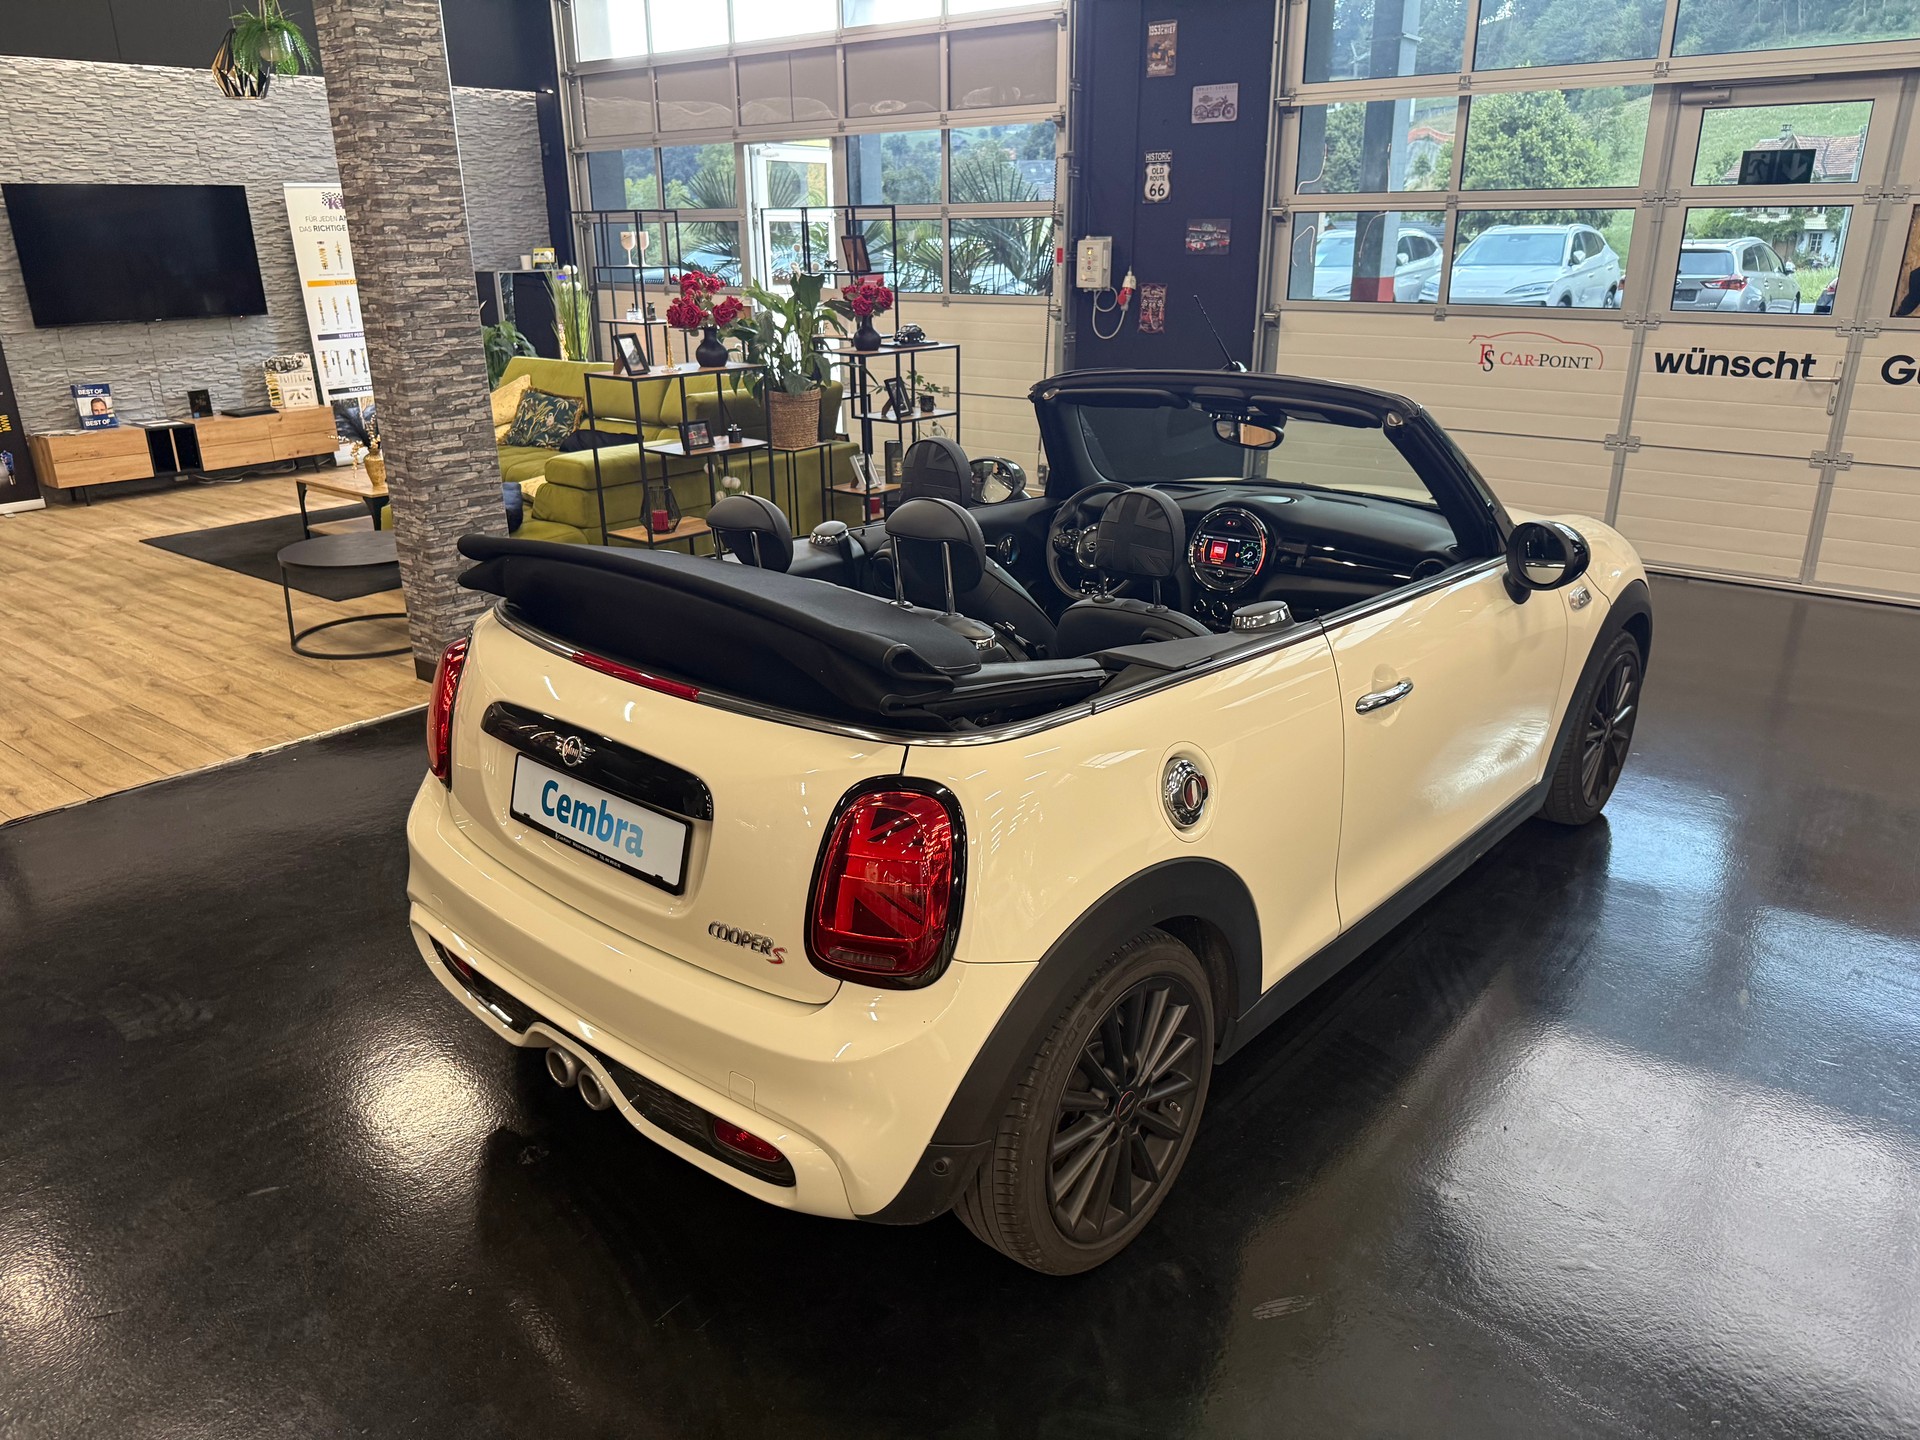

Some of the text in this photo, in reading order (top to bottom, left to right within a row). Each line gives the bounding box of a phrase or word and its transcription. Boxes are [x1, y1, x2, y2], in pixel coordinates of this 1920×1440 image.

[1145, 152, 1171, 161] HISTORIC
[1149, 183, 1165, 197] 66
[1500, 351, 1593, 370] CAR-POINT
[1654, 347, 1920, 386] wünscht G
[541, 780, 644, 858] Cembra
[708, 921, 774, 956] COOPER
